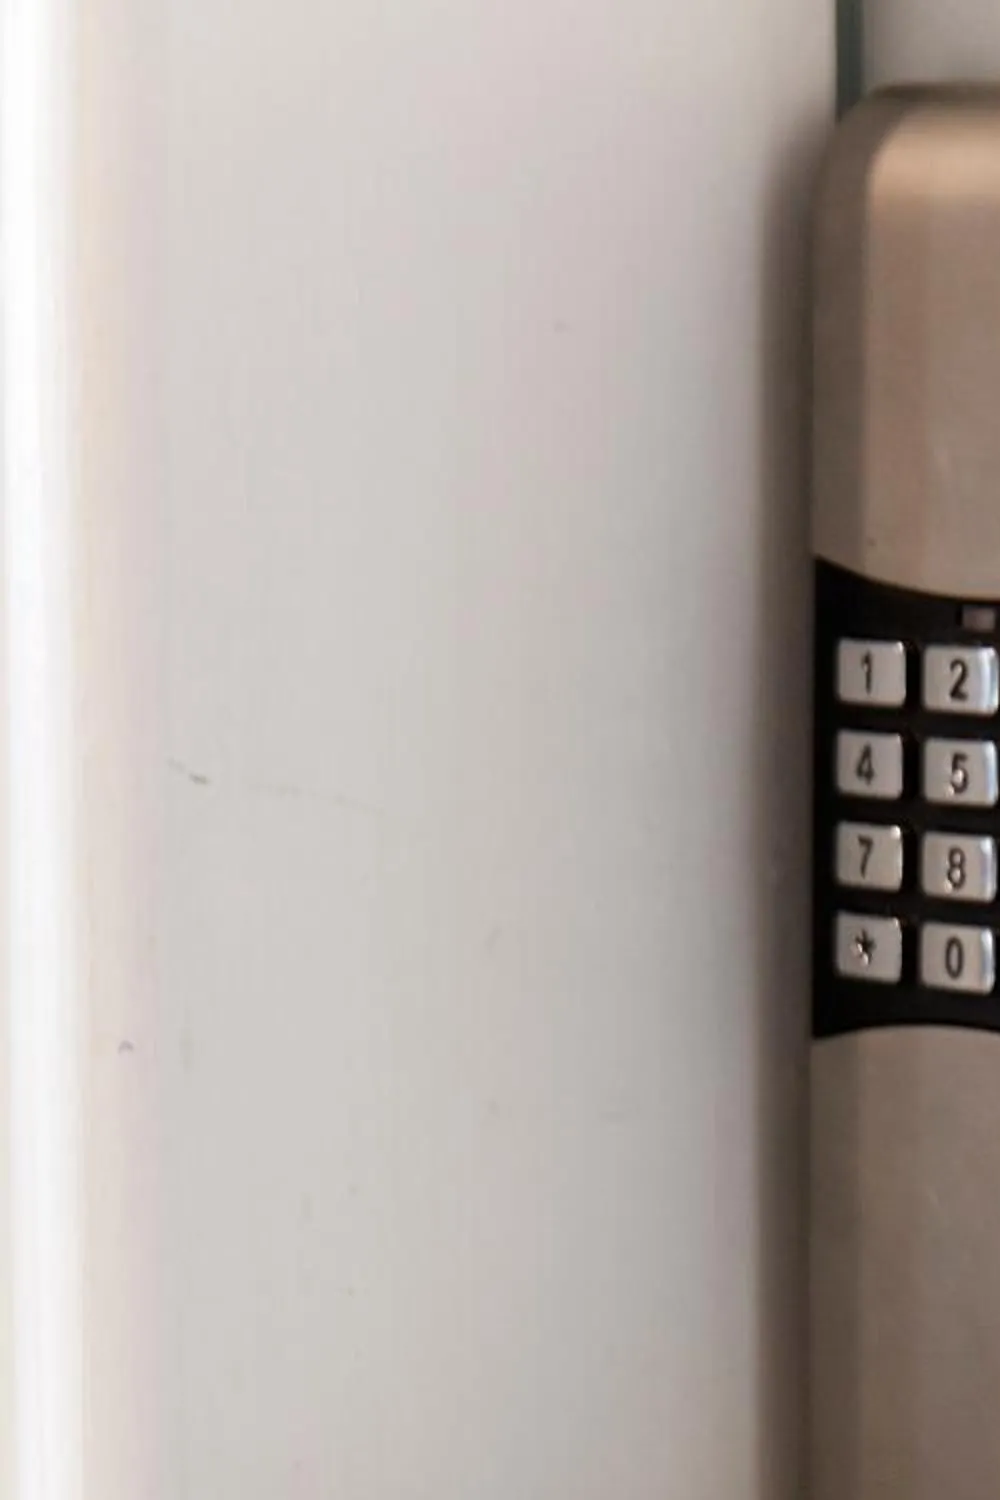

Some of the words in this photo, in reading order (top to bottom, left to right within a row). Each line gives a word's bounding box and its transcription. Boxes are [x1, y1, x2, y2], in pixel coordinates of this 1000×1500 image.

[949, 659, 968, 702] 2
[856, 744, 873, 785] 4
[951, 754, 968, 794] 5
[858, 836, 873, 876] 7
[947, 848, 965, 890] 8
[945, 937, 963, 978] 0
